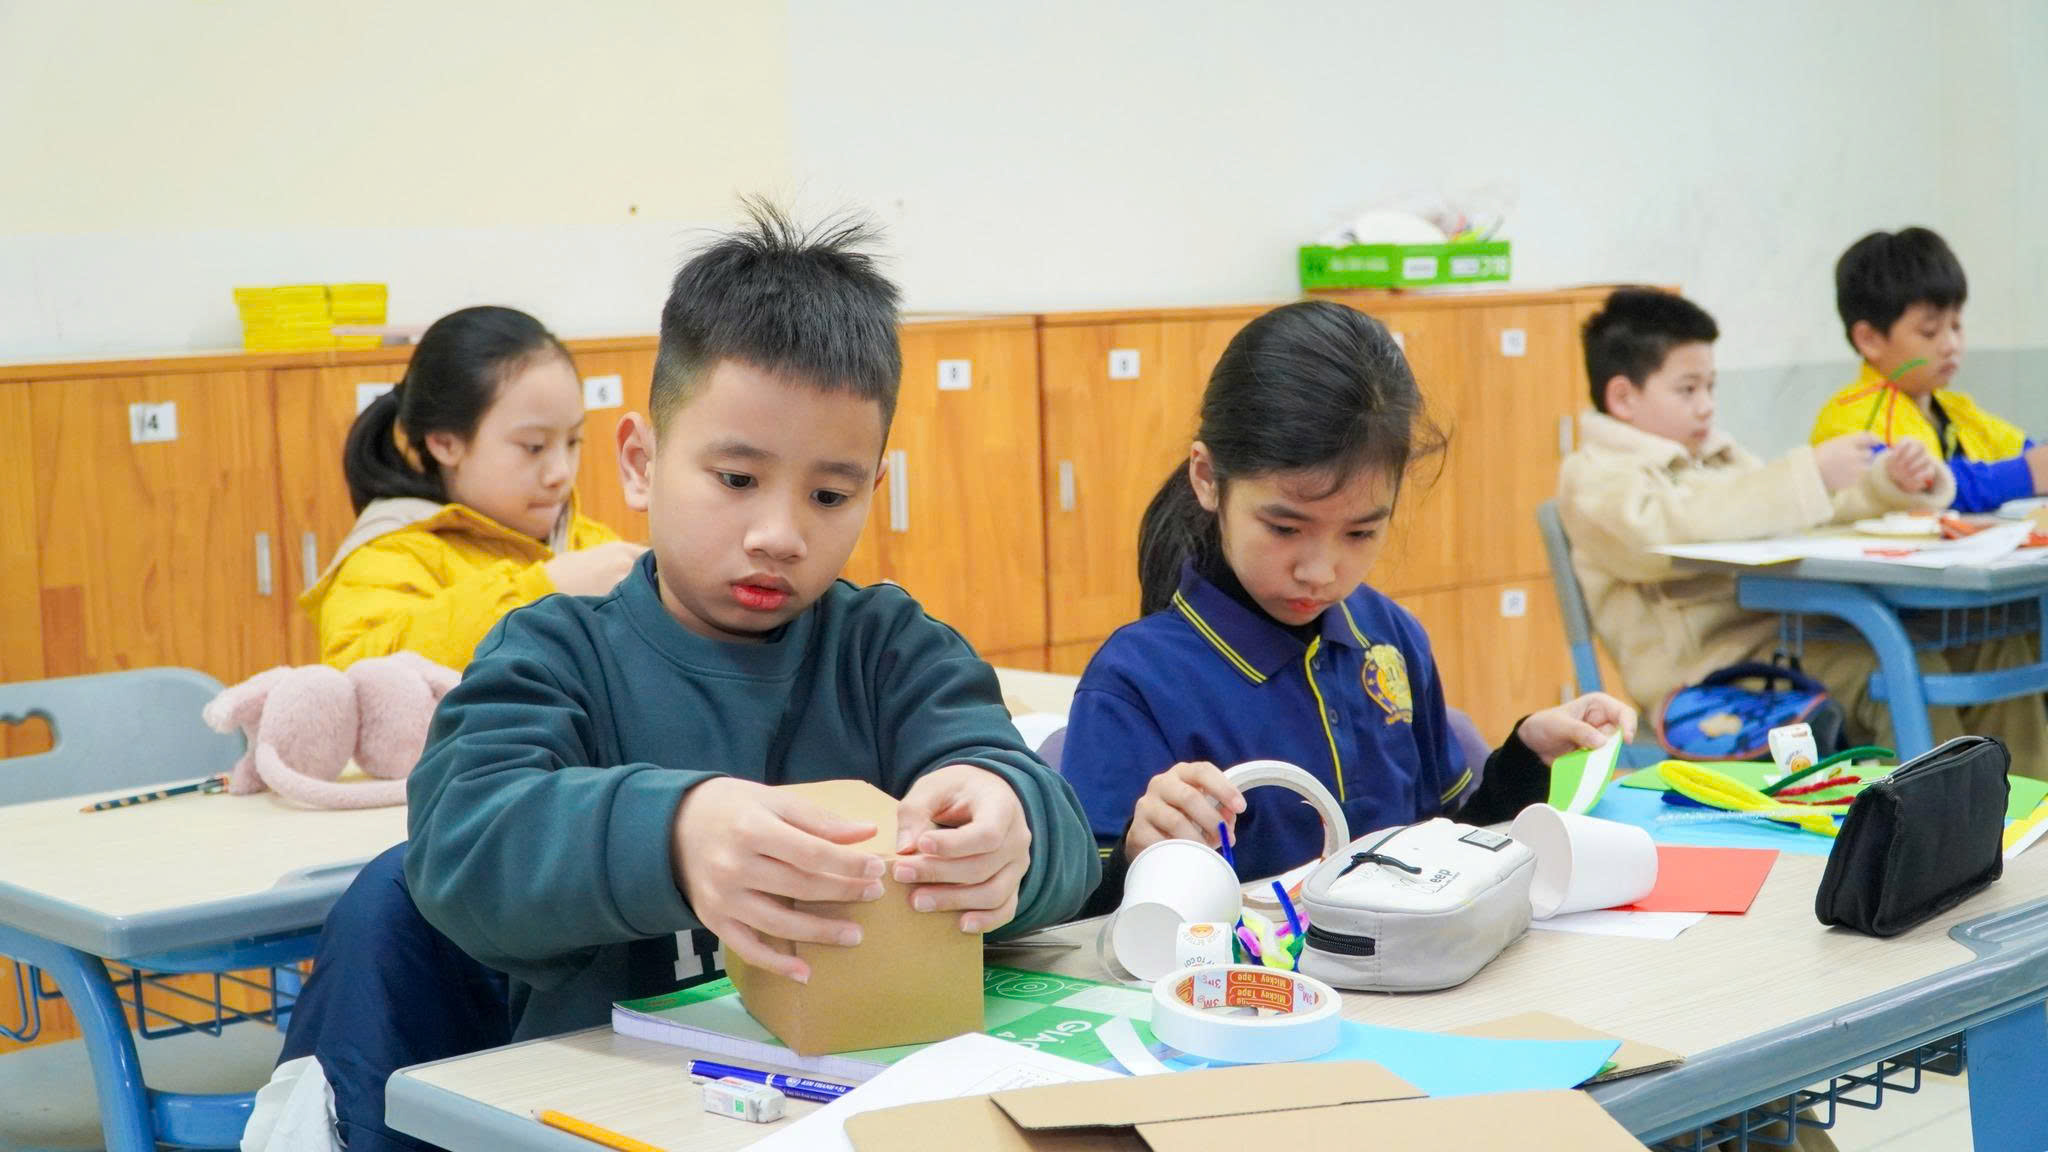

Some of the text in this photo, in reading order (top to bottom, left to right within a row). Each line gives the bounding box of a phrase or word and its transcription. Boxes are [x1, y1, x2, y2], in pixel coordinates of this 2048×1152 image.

[1237, 971, 1287, 988] Mickey Tape
[1237, 989, 1257, 999] Tape
[1260, 989, 1287, 1004] Mickey
